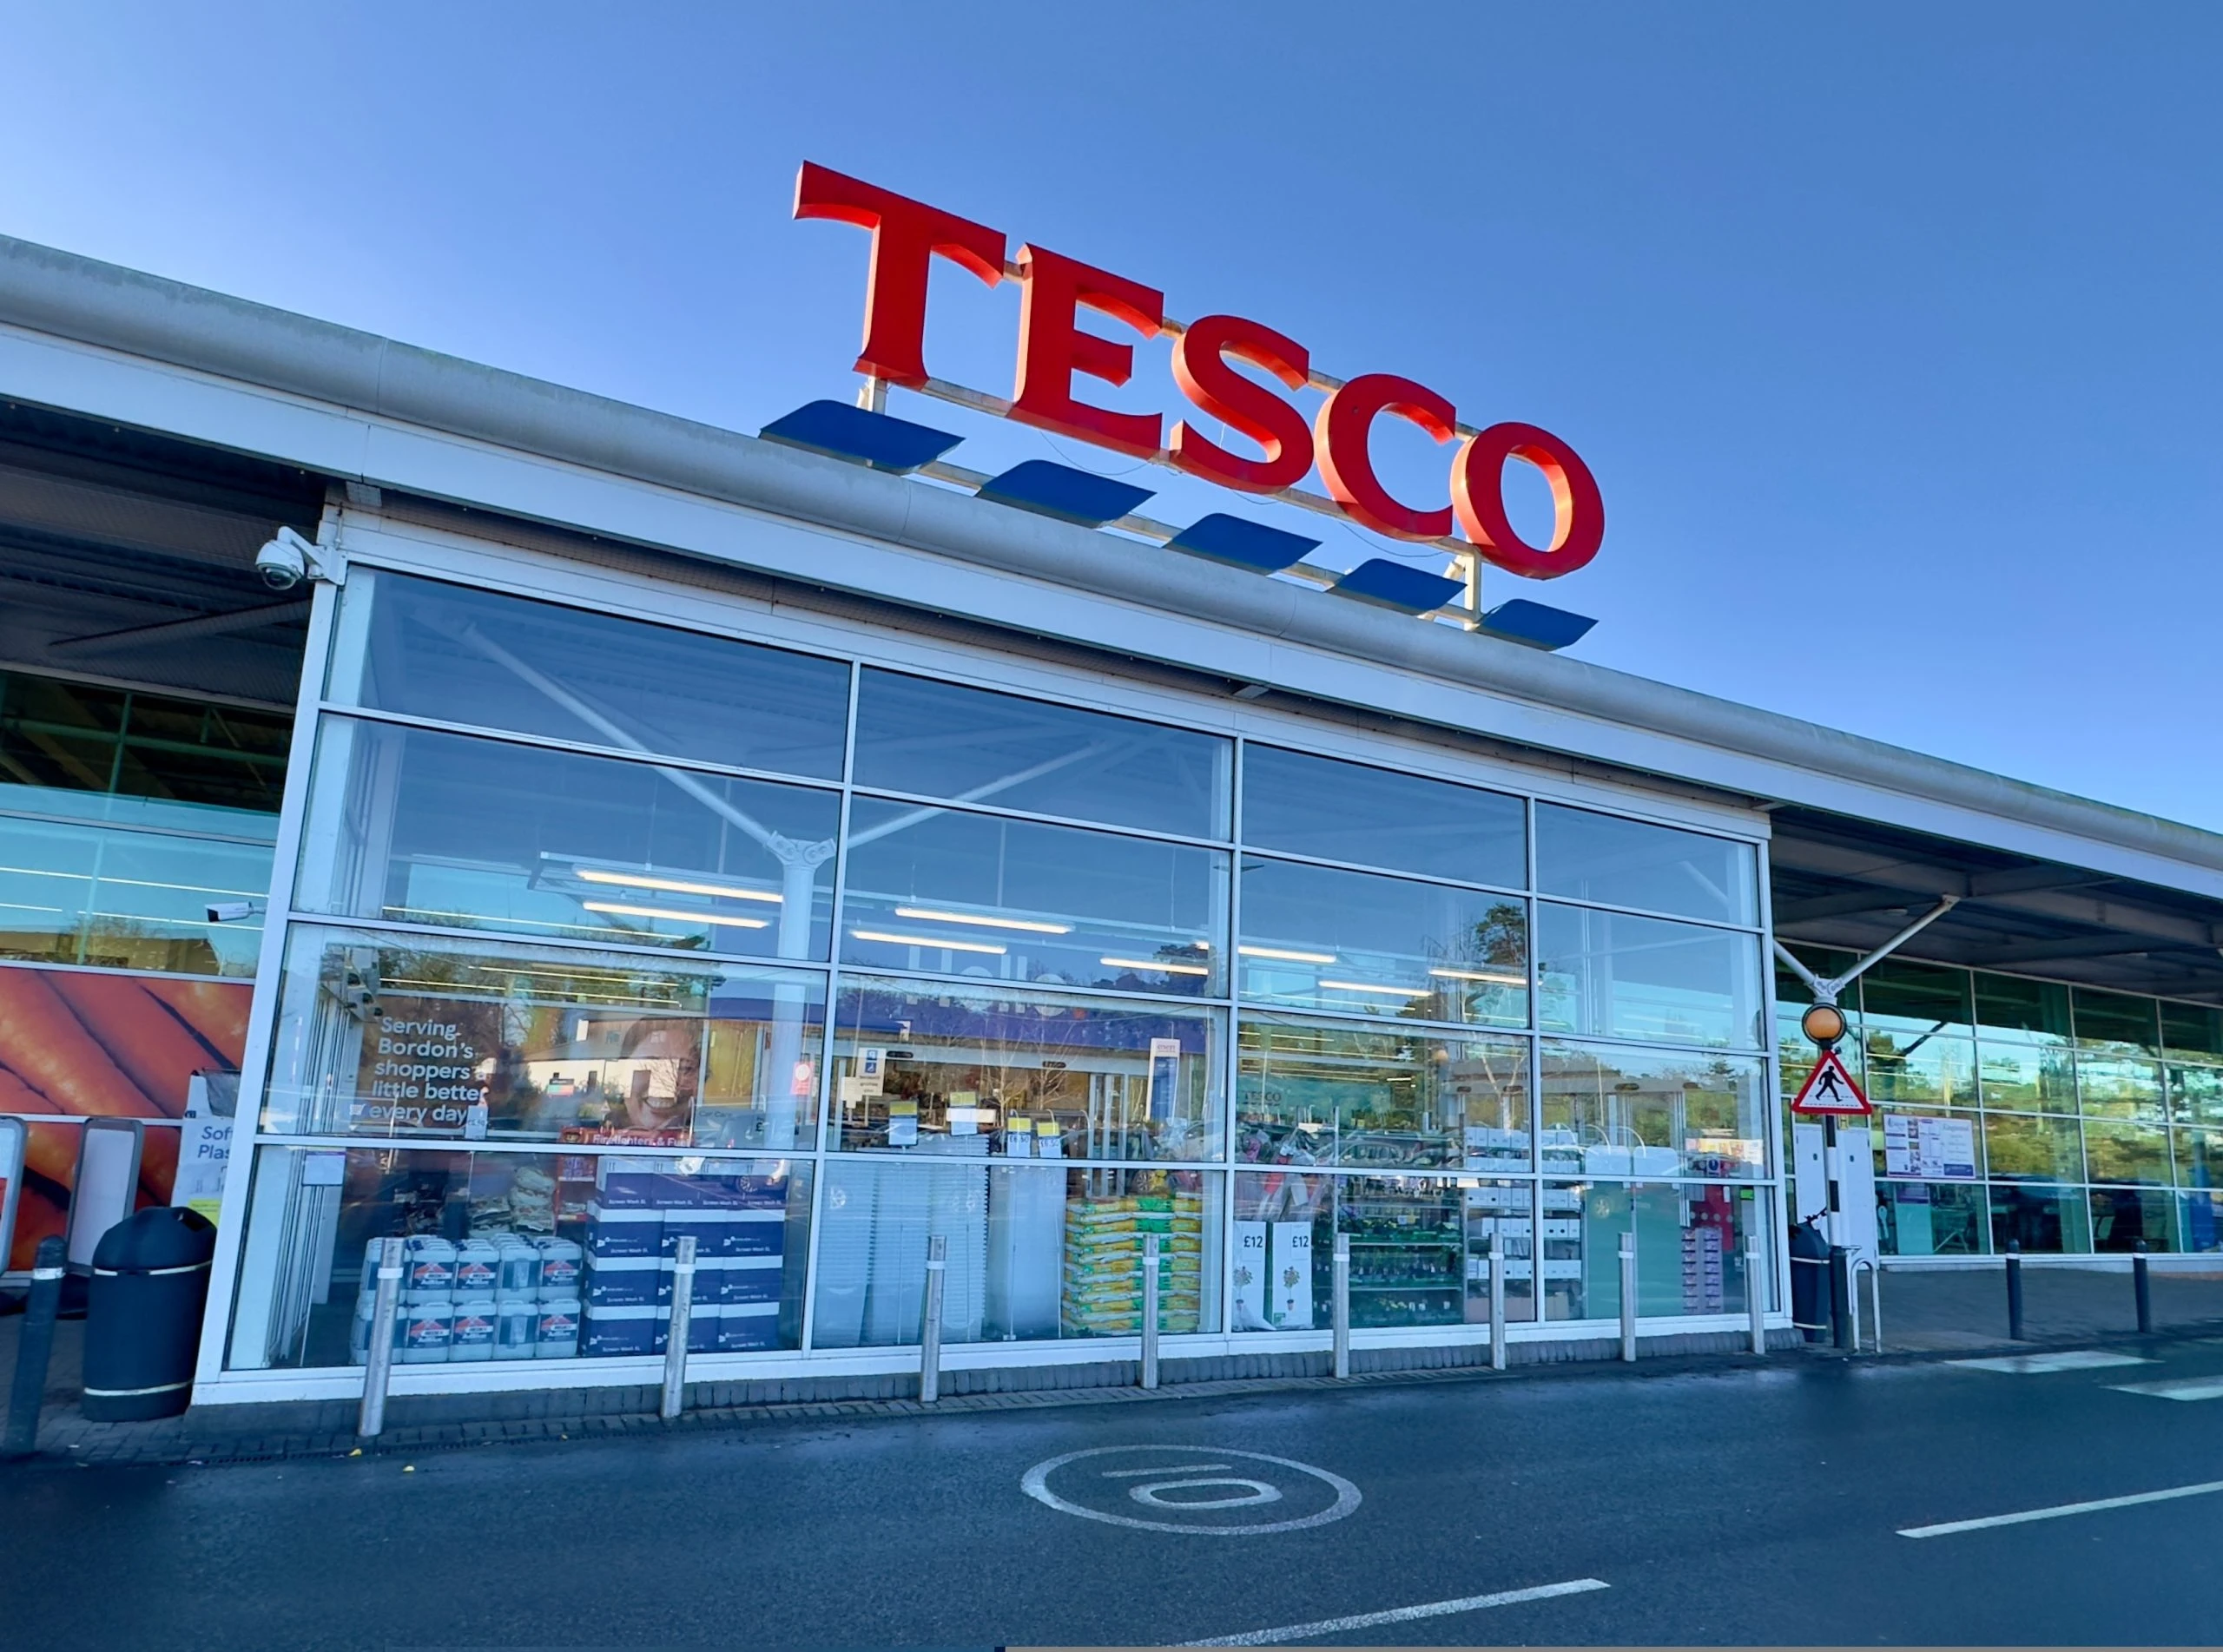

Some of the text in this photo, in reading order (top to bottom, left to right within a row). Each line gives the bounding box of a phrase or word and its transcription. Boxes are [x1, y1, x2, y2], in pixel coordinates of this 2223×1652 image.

[793, 159, 1606, 581] TESCO
[380, 1017, 458, 1041] Serving
[378, 1037, 474, 1059] Bordon's
[374, 1059, 471, 1082] shoppers
[372, 1080, 419, 1098] little
[369, 1104, 468, 1129] every day
[201, 1125, 234, 1142] Sof
[197, 1143, 230, 1160] Plas
[1243, 1235, 1263, 1248] £12
[1291, 1235, 1309, 1248] £12
[1101, 1463, 1283, 1510] 10
